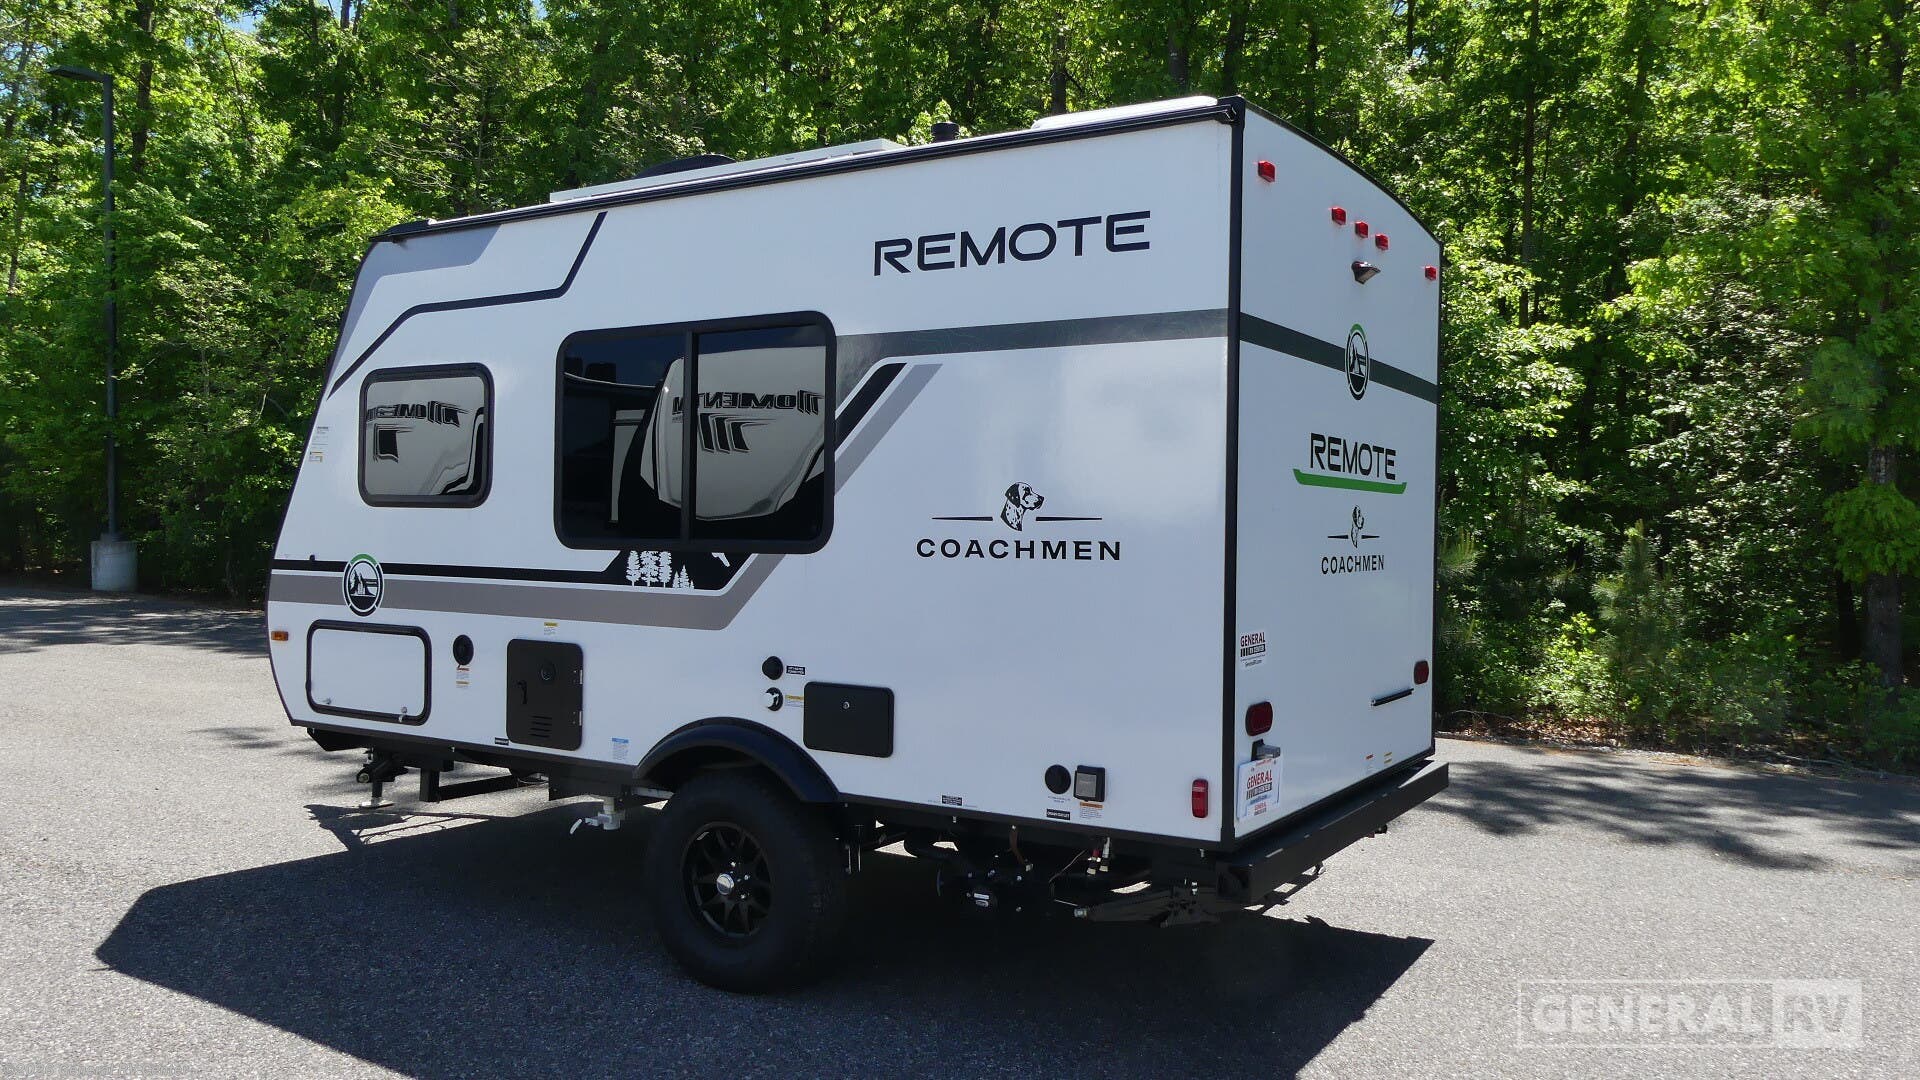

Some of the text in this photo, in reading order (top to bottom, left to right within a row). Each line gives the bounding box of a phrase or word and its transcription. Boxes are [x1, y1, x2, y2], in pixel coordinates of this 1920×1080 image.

[873, 210, 1151, 276] REMOTE
[1310, 432, 1396, 480] REMOTE
[916, 538, 1121, 561] COACHMEN
[1321, 555, 1385, 575] COACHMEN
[1240, 631, 1266, 647] GENERAL
[1246, 769, 1273, 790] GENERAL
